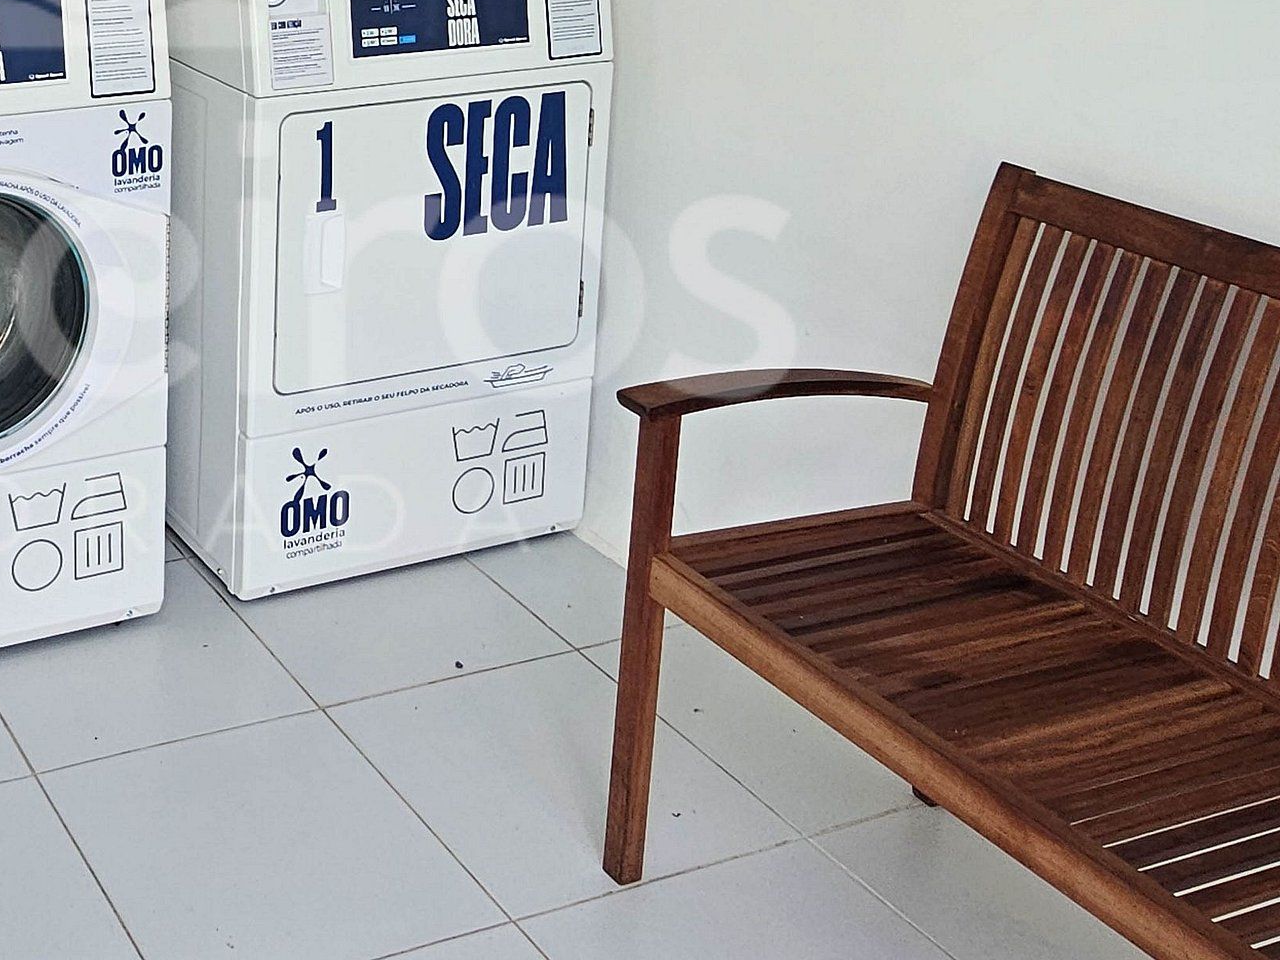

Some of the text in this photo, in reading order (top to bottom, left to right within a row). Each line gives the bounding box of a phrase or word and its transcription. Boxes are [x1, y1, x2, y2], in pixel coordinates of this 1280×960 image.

[447, 17, 481, 48] DORA
[111, 144, 163, 178] OMO
[315, 120, 338, 214] 1
[423, 90, 569, 242] SECA
[114, 174, 161, 186] lavanderia
[295, 406, 316, 415] APÓS
[381, 393, 395, 401] SEU
[420, 386, 430, 394] DA
[431, 380, 469, 391] SECADORA
[0, 443, 34, 464] borracha
[280, 489, 350, 538] OMO
[283, 527, 346, 550] lavanderia
